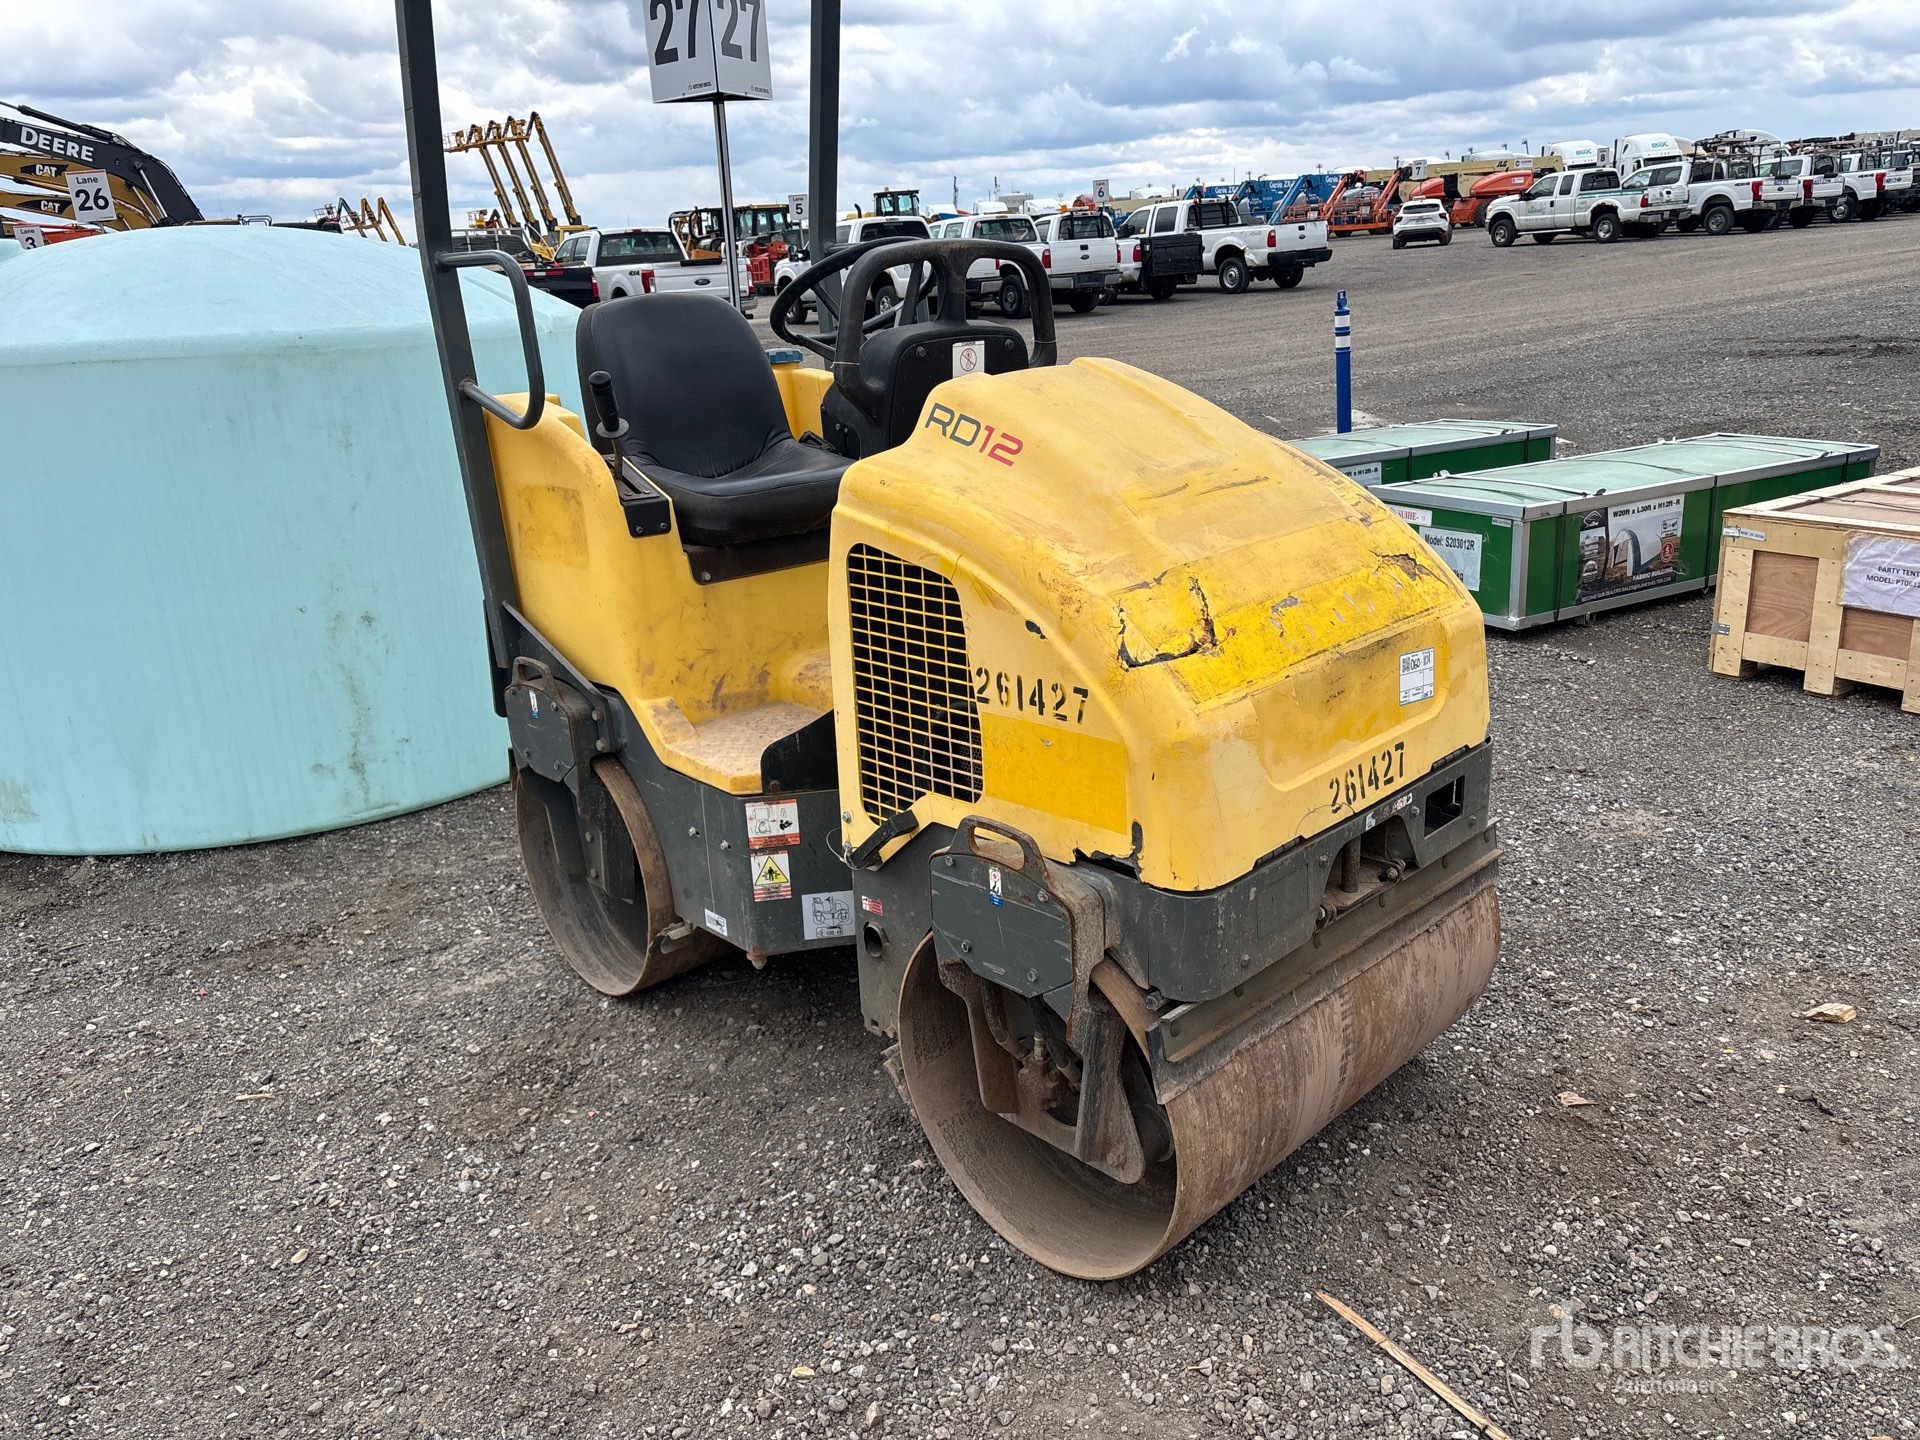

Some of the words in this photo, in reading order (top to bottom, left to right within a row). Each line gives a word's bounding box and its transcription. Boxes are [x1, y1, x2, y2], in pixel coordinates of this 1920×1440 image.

[650, 0, 699, 65] 27
[717, 0, 760, 62] 27
[20, 126, 94, 162] DEERE
[1884, 137, 1895, 145] 10
[1496, 160, 1508, 168] JLG
[1600, 153, 1606, 162] 8
[35, 164, 57, 178] CAT
[1415, 166, 1421, 176] 7
[76, 176, 98, 185] Lane
[1097, 187, 1105, 198] 6
[1214, 186, 1228, 194] Genie
[40, 200, 60, 213] CAT
[74, 188, 110, 212] 26
[795, 203, 804, 215] 5
[924, 402, 1024, 467] RD12
[1613, 508, 1630, 518] W20ft
[1636, 504, 1652, 514] L30ft
[1424, 533, 1444, 547] Model:
[1445, 536, 1475, 551] S203012R
[1632, 571, 1651, 582] FABRIC
[1651, 566, 1674, 577] BUILDING
[1877, 565, 1900, 575] PARTY
[1901, 568, 1920, 578] TENT
[1865, 574, 1894, 585] MODEL:
[1895, 579, 1920, 589] PT0612
[975, 666, 1089, 725] 261427
[1328, 741, 1405, 814] 261427
